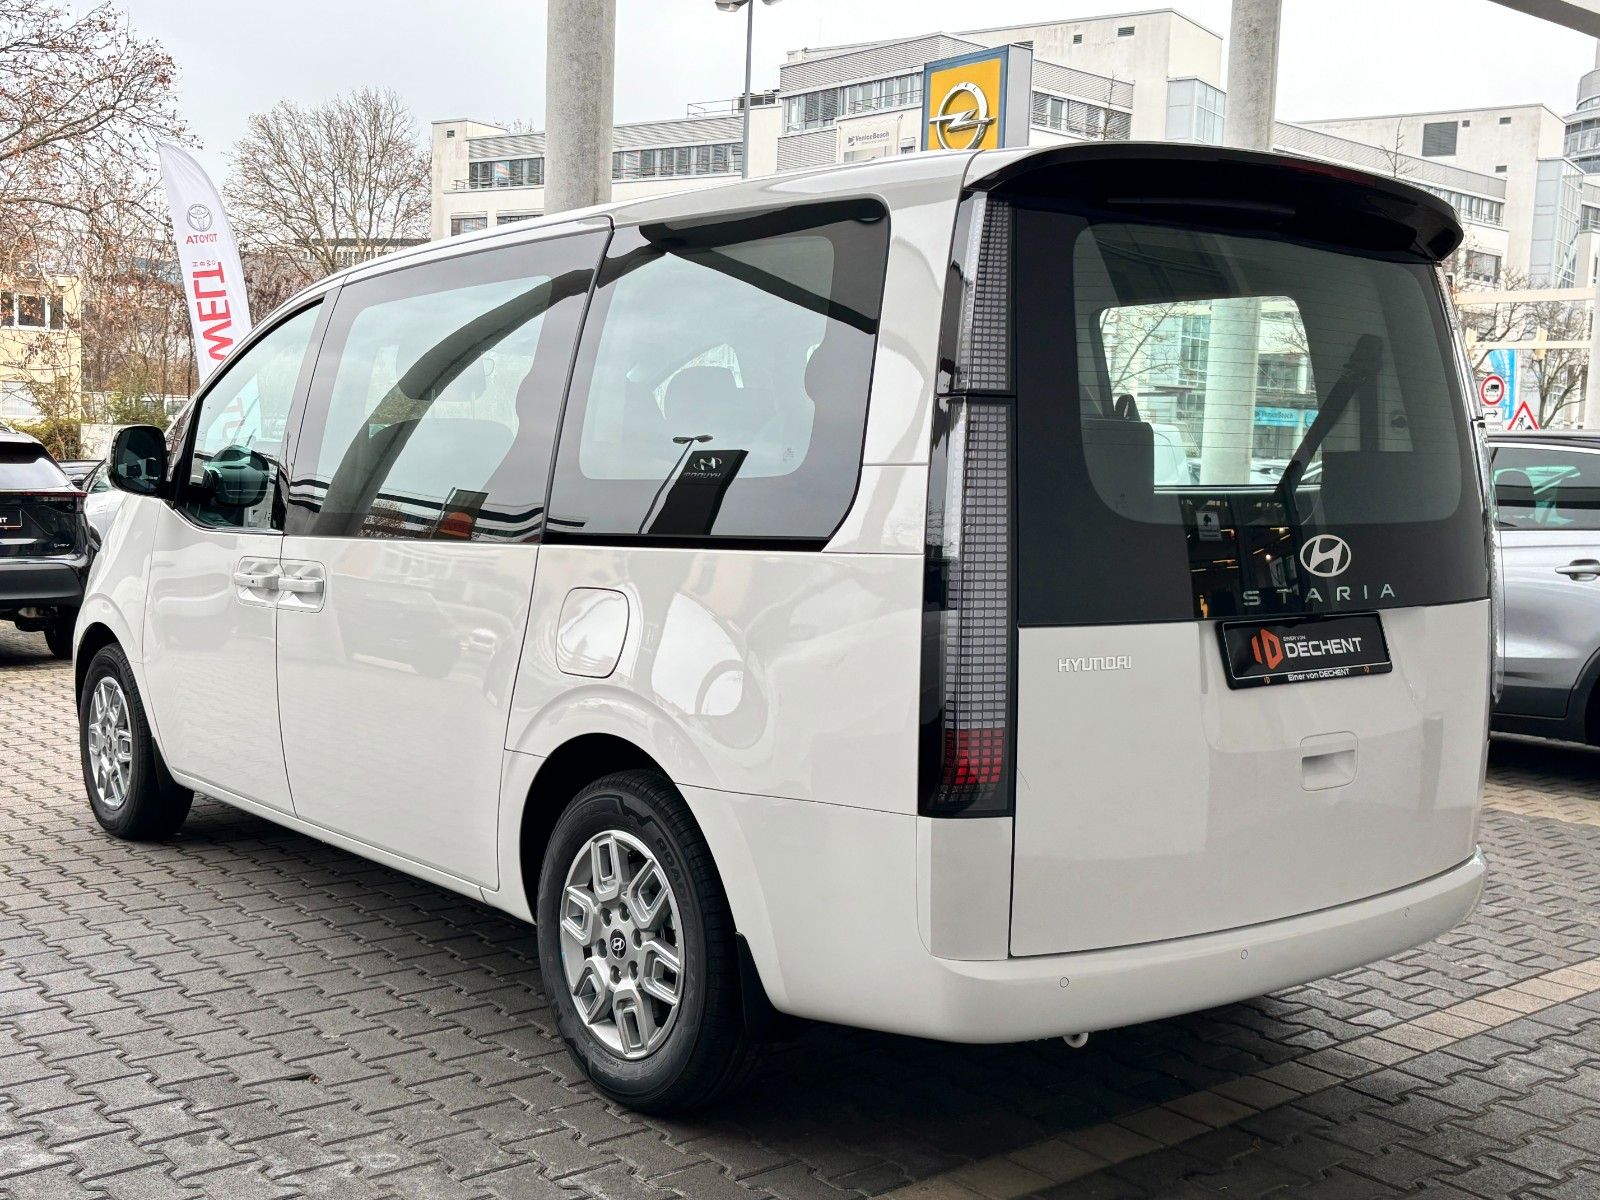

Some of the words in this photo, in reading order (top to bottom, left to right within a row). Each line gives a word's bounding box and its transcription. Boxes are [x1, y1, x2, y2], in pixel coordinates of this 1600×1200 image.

[1243, 583, 1396, 606] STARIA
[1284, 637, 1362, 659] DECHENT
[1058, 655, 1132, 673] HYUNDAI
[1287, 673, 1305, 682] Einer
[1306, 672, 1319, 680] von
[1319, 668, 1350, 678] DECHENT
